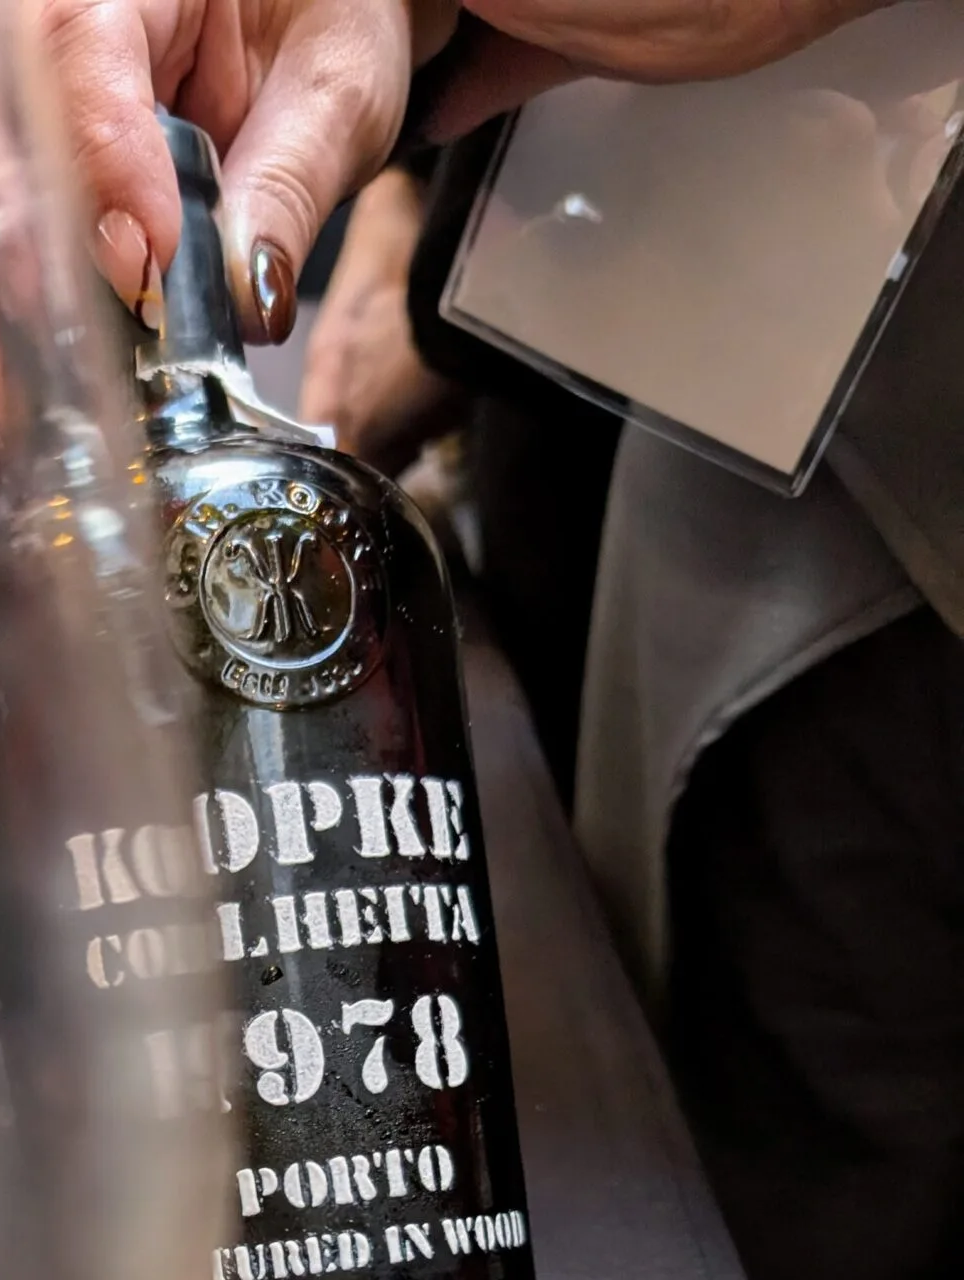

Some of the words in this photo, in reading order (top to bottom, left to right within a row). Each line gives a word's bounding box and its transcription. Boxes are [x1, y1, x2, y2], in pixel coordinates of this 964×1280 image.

[65, 773, 471, 911] KOPKE
[86, 885, 480, 989] COLHEITA
[236, 1145, 454, 1217] PORTO
[385, 1222, 435, 1264] IN
[441, 1209, 527, 1256] WOOD
